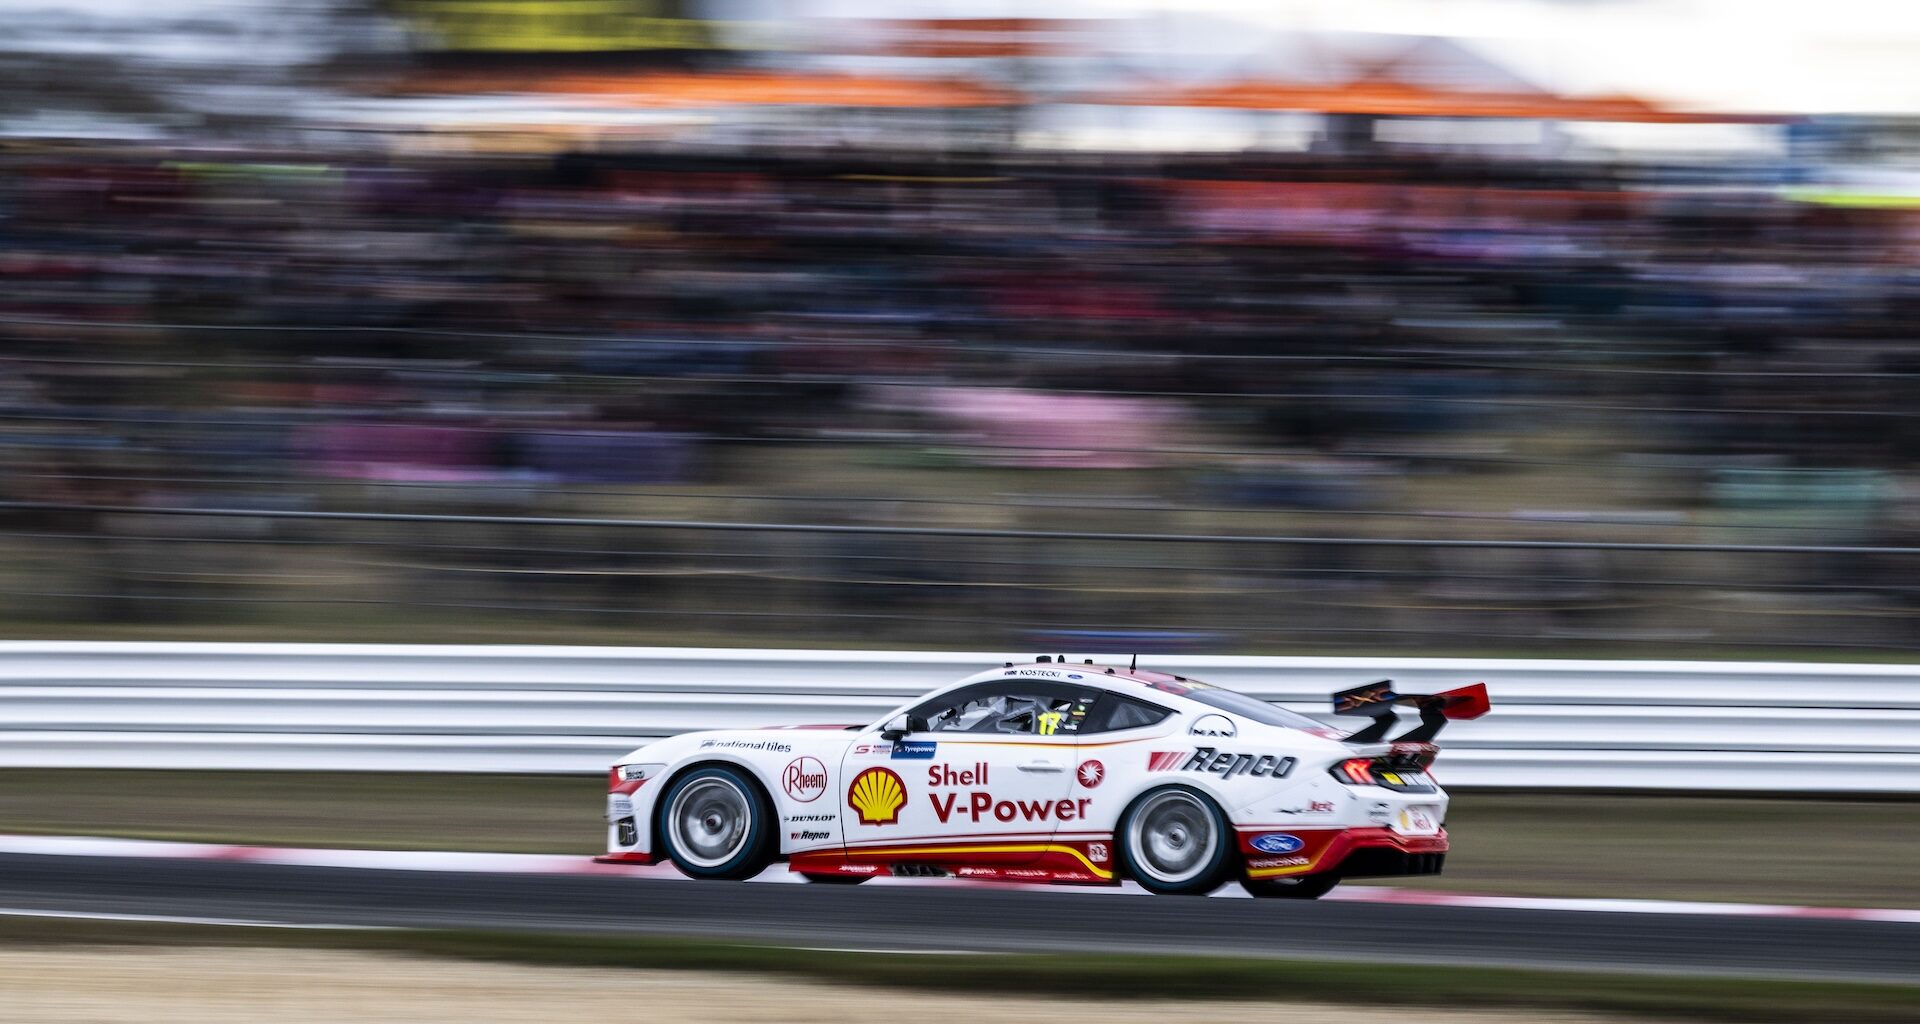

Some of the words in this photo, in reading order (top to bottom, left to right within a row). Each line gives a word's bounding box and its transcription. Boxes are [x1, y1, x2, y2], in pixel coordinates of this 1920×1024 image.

[1037, 712, 1061, 736] 17
[1190, 728, 1235, 737] MAN
[716, 740, 766, 750] national
[766, 742, 791, 753] tiles
[904, 745, 936, 753] Tyrepower
[1182, 747, 1299, 780] Repco
[789, 757, 824, 795] Rheem
[928, 762, 989, 787] Shell
[928, 792, 1093, 824] V-Power
[790, 814, 836, 822] DUNLOP
[800, 830, 830, 841] Repco
